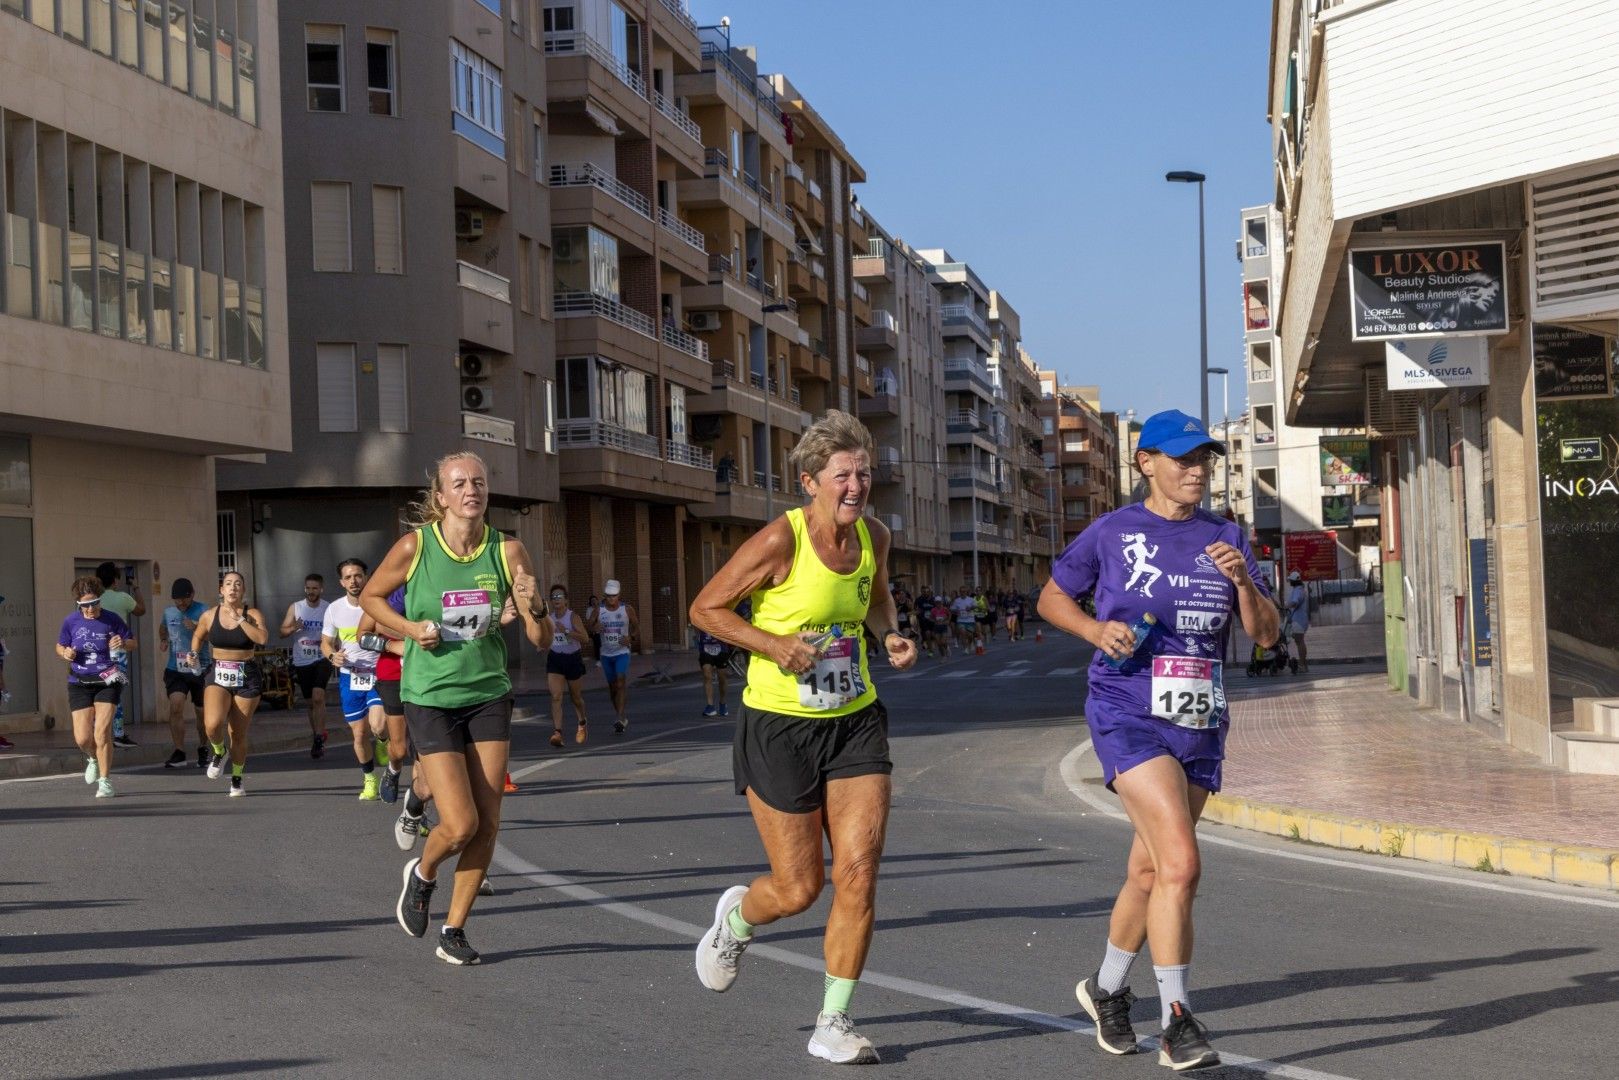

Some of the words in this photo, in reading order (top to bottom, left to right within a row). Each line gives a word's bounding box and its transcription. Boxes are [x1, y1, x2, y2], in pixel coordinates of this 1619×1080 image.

[1373, 250, 1482, 276] LUXOR
[1385, 277, 1424, 288] Beauty
[1428, 273, 1471, 285] Studios
[1390, 291, 1424, 302] Malinka
[1360, 325, 1373, 333] +34
[1374, 325, 1387, 333] 674
[1408, 323, 1417, 331] 03
[1404, 370, 1425, 378] MLS
[1428, 367, 1473, 377] ASIVEGA
[1167, 574, 1189, 587] VII
[1188, 600, 1215, 608] OCTUBRE
[452, 615, 478, 629] 41
[1181, 616, 1199, 626] TM
[217, 672, 236, 681] 198
[804, 670, 852, 695] 115
[1159, 691, 1211, 714] 125
